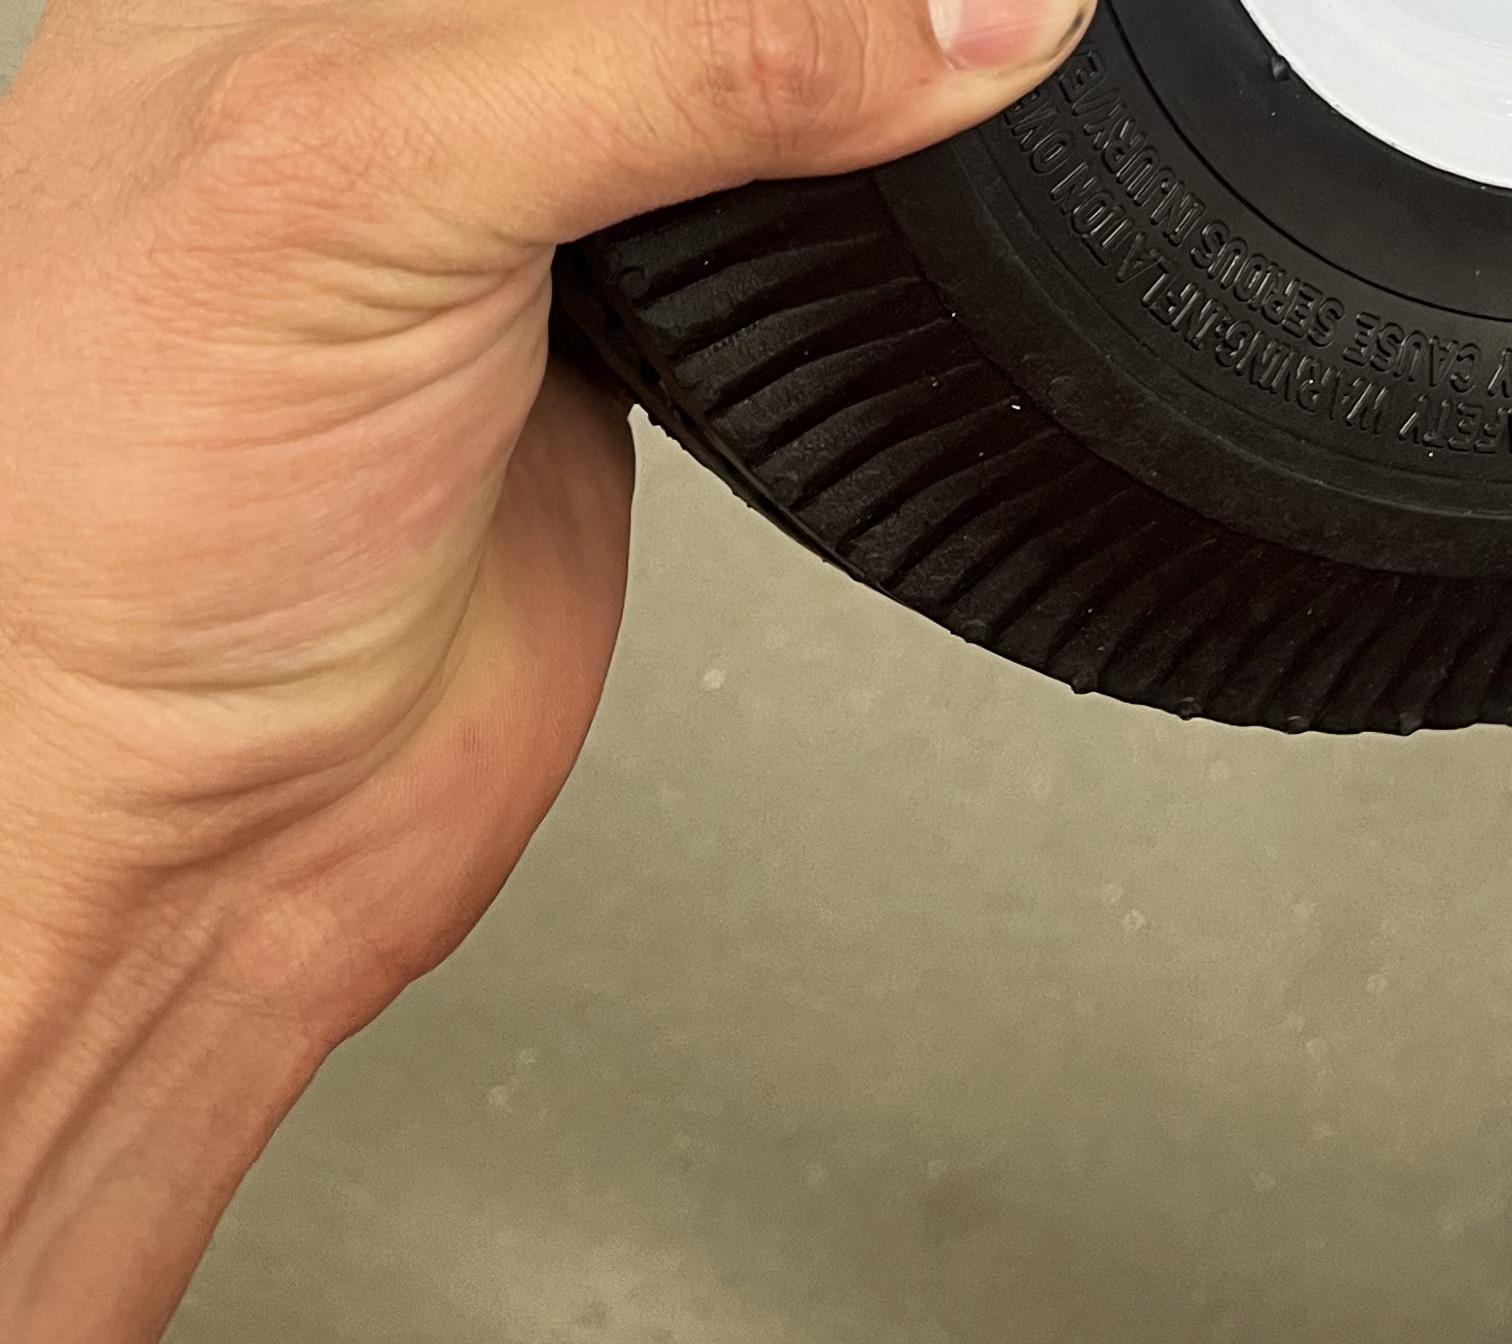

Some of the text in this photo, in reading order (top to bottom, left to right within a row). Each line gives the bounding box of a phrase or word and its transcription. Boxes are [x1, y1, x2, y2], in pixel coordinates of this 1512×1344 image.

[1003, 88, 1073, 176] OVE
[1190, 218, 1344, 349] SERIOUS
[1342, 311, 1481, 395] CAUSE
